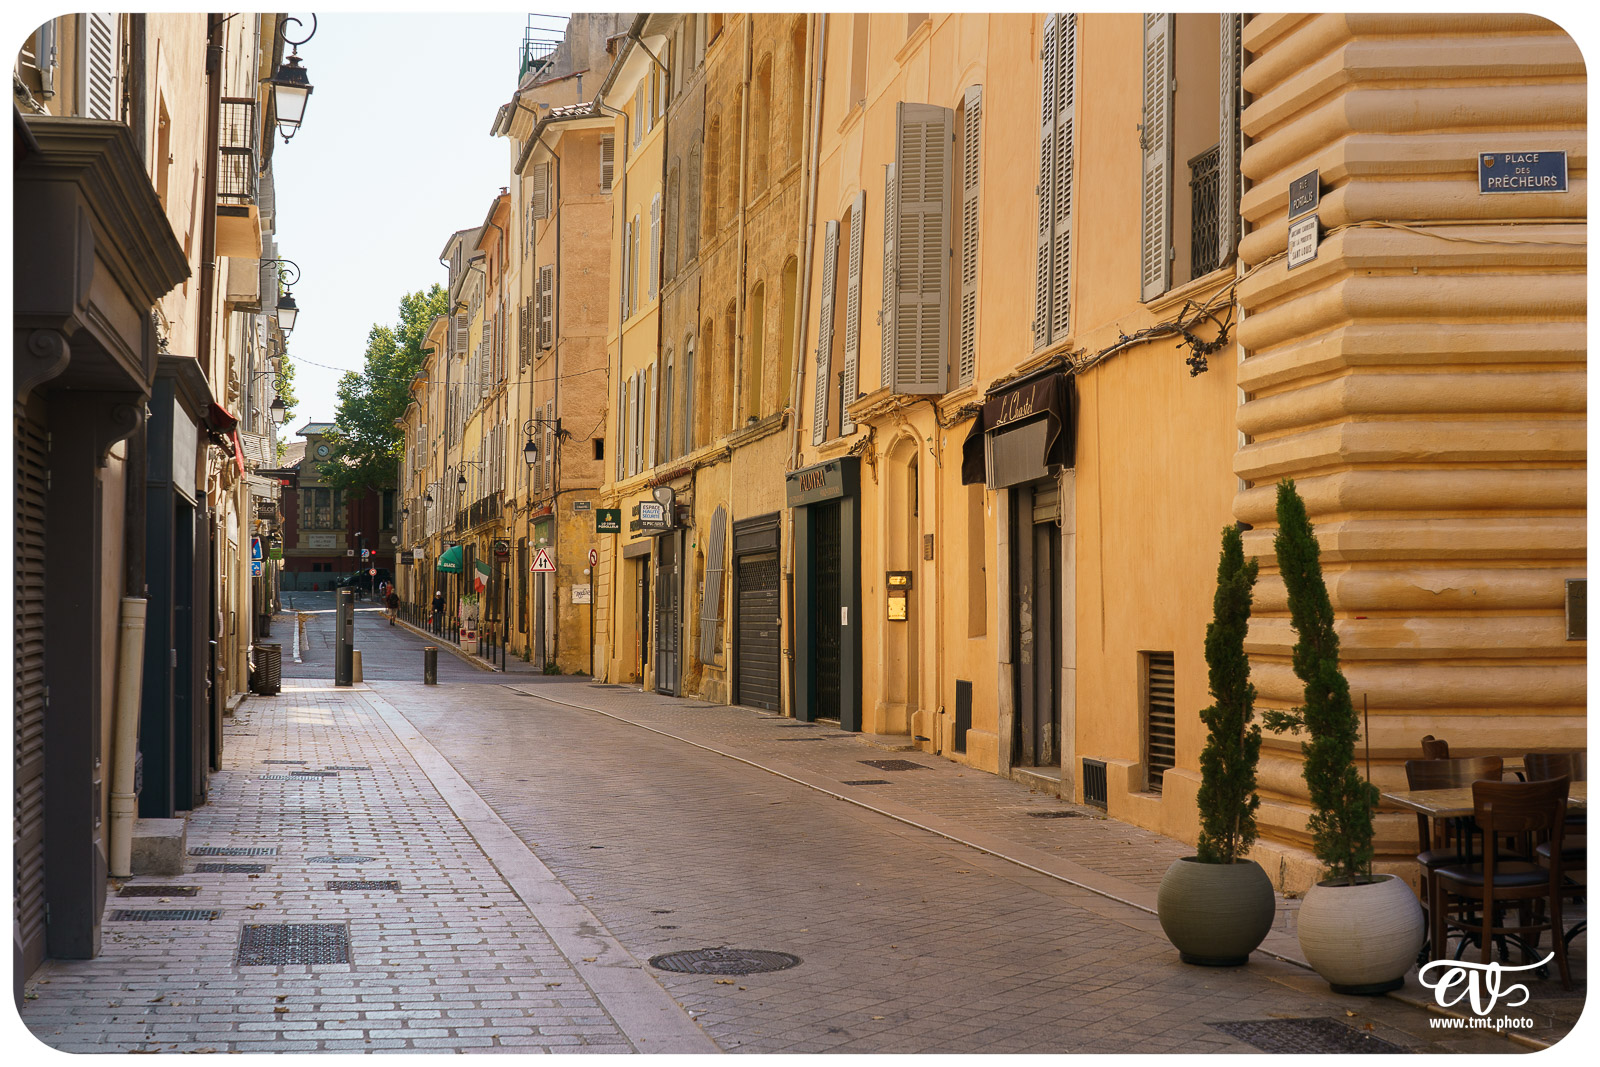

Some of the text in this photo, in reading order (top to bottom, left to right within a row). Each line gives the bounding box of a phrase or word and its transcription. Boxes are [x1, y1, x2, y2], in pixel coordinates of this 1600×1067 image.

[1505, 153, 1539, 163] PLACE
[1488, 174, 1558, 188] PRÊCHEURS
[1293, 191, 1313, 209] PORTALIS
[996, 385, 1036, 425] Le Chastel
[799, 469, 826, 492] PALMYRA
